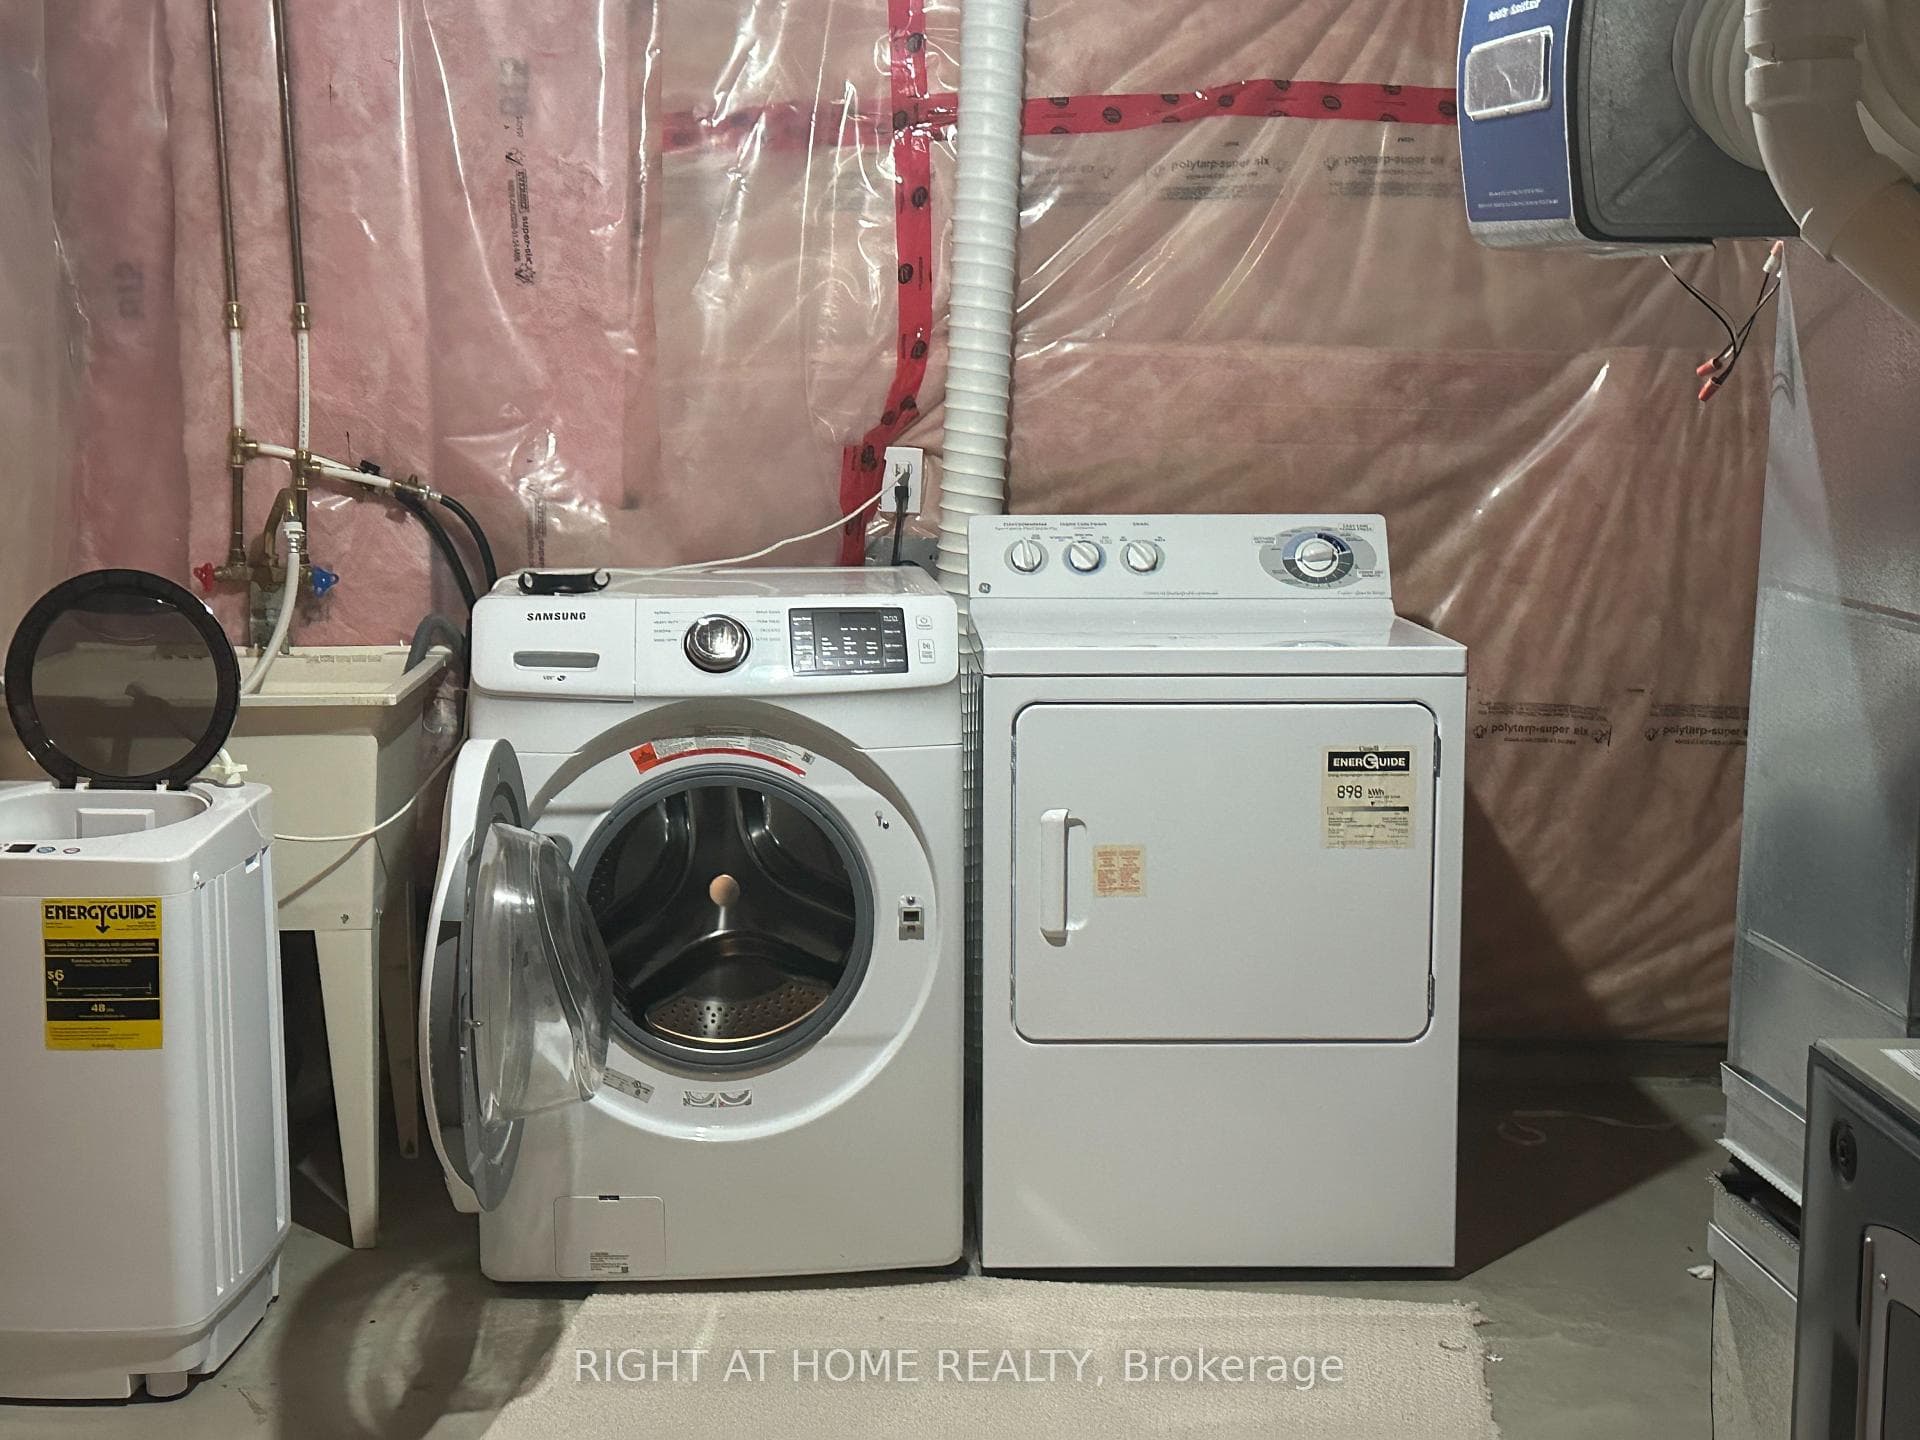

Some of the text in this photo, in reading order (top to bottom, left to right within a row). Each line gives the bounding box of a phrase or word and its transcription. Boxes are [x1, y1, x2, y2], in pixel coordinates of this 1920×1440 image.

[526, 611, 587, 622] SAMSUNG
[1490, 722, 1570, 736] polytarp-super
[1332, 753, 1406, 769] ENERGUIDE
[1337, 784, 1363, 799] 898
[44, 904, 157, 920] ENERGYGUIDE
